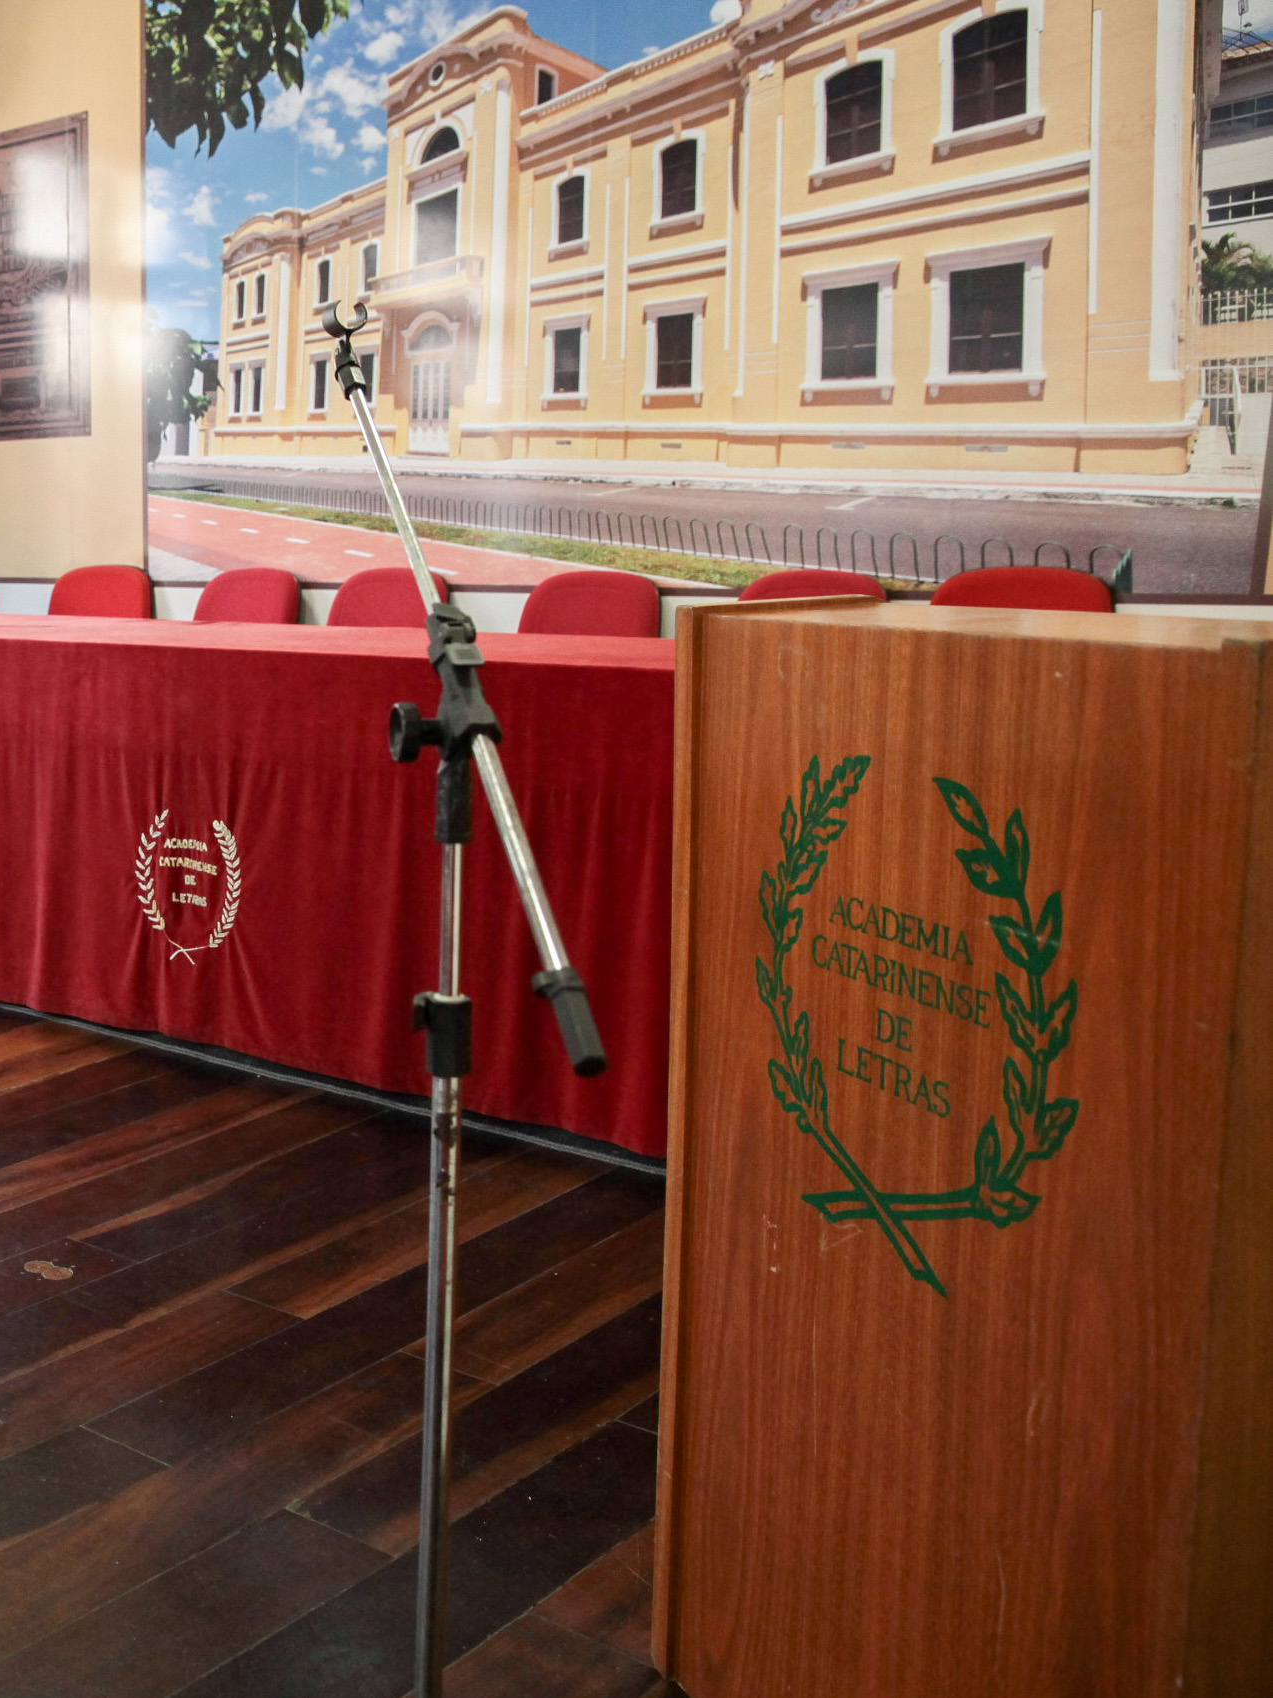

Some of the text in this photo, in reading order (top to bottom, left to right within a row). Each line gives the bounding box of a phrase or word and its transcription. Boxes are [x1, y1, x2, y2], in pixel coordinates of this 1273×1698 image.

[159, 856, 218, 876] CATARINENSE
[184, 875, 196, 886] DE
[172, 892, 207, 907] LETRAS
[829, 895, 974, 966] ACADEMIA
[811, 934, 992, 1028] CATARINENSE
[876, 1008, 913, 1052] DE
[837, 1037, 951, 1118] LETRAS
